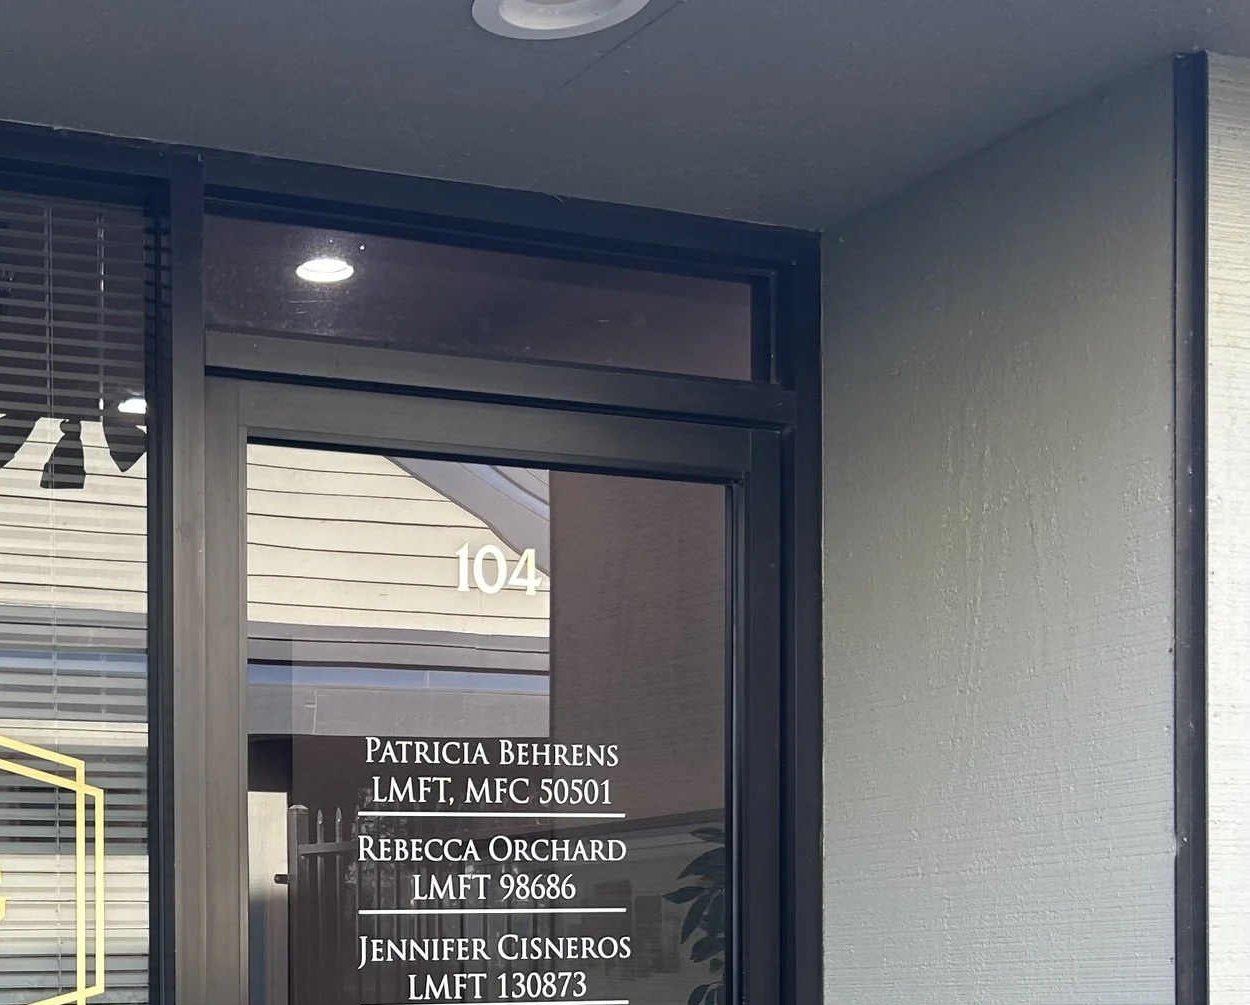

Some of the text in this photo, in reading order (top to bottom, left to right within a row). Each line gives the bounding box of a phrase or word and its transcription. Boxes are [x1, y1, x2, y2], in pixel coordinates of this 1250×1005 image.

[455, 541, 543, 596] 104
[365, 737, 619, 768] PATRICIA BEHRENS
[372, 776, 612, 806] LMFT, MFC 50501
[357, 835, 627, 862] REBECCA ORCHARD
[411, 873, 576, 900] LMFT 98686
[357, 934, 631, 970] JENNIFER CISNEROS
[408, 971, 587, 1000] LMFT 130873
